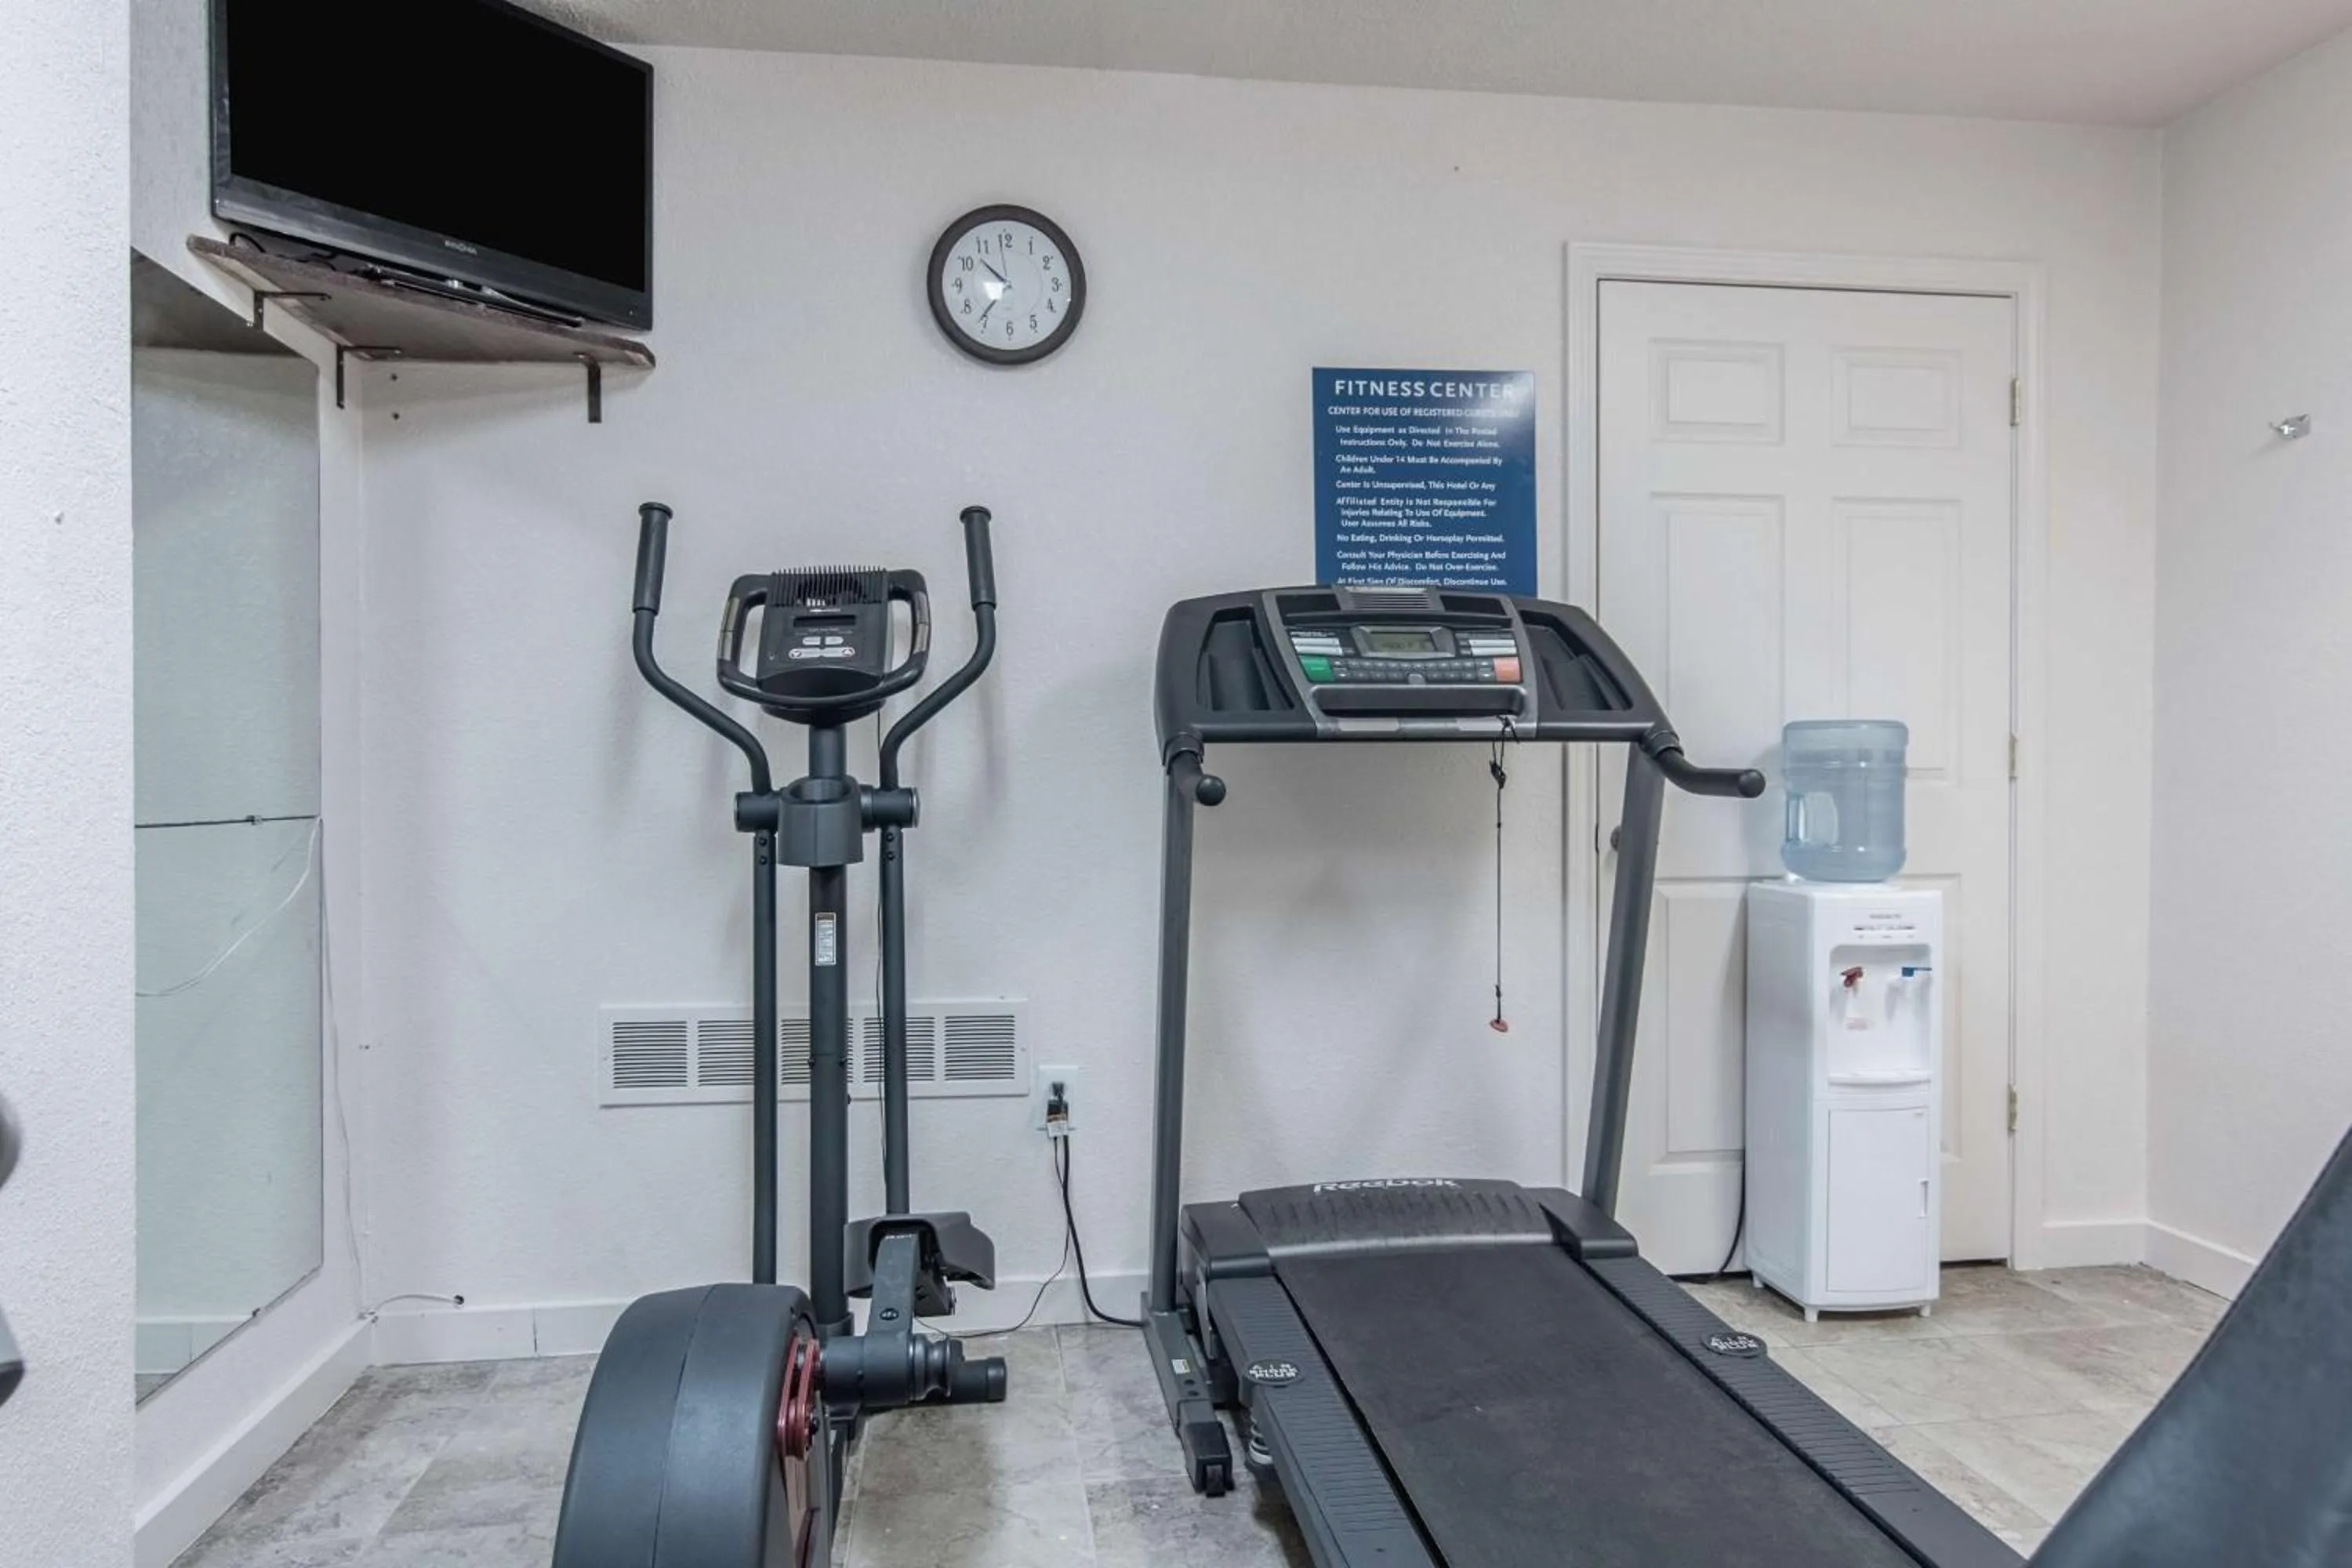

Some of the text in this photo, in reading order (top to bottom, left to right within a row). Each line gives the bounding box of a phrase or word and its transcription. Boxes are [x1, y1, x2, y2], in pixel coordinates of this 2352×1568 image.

[976, 238, 989, 255] 11
[960, 256, 974, 271] 10
[1042, 255, 1051, 270] 2
[954, 278, 963, 294] 9
[1051, 278, 1060, 292] 3
[964, 299, 972, 314] 8
[1047, 298, 1057, 314] 4
[1006, 321, 1014, 336] 6
[1029, 314, 1038, 330] 5
[1334, 379, 1515, 398] FITNESS CENTER
[1328, 407, 1361, 416] CENTER
[1413, 408, 1462, 417] REGISTERED
[1388, 439, 1406, 448] Only.
[1440, 456, 1490, 466] Accompanied
[1372, 481, 1426, 491] Unsupervised,
[1481, 481, 1496, 491] Any
[1433, 499, 1481, 508] Responsible
[1341, 509, 1370, 517] Injuries
[1372, 508, 1403, 517] Relating
[1444, 510, 1486, 519] Equipment.
[1361, 519, 1396, 528] Assumes
[1352, 535, 1377, 544] Eating,
[1380, 535, 1411, 544] Drinking
[1426, 535, 1464, 544] Horseplay
[1369, 550, 1385, 559] Your
[1388, 550, 1422, 561] Physician
[1425, 550, 1449, 559] Before
[1451, 551, 1488, 561] Exercising
[1313, 1179, 1461, 1194] Reebok
